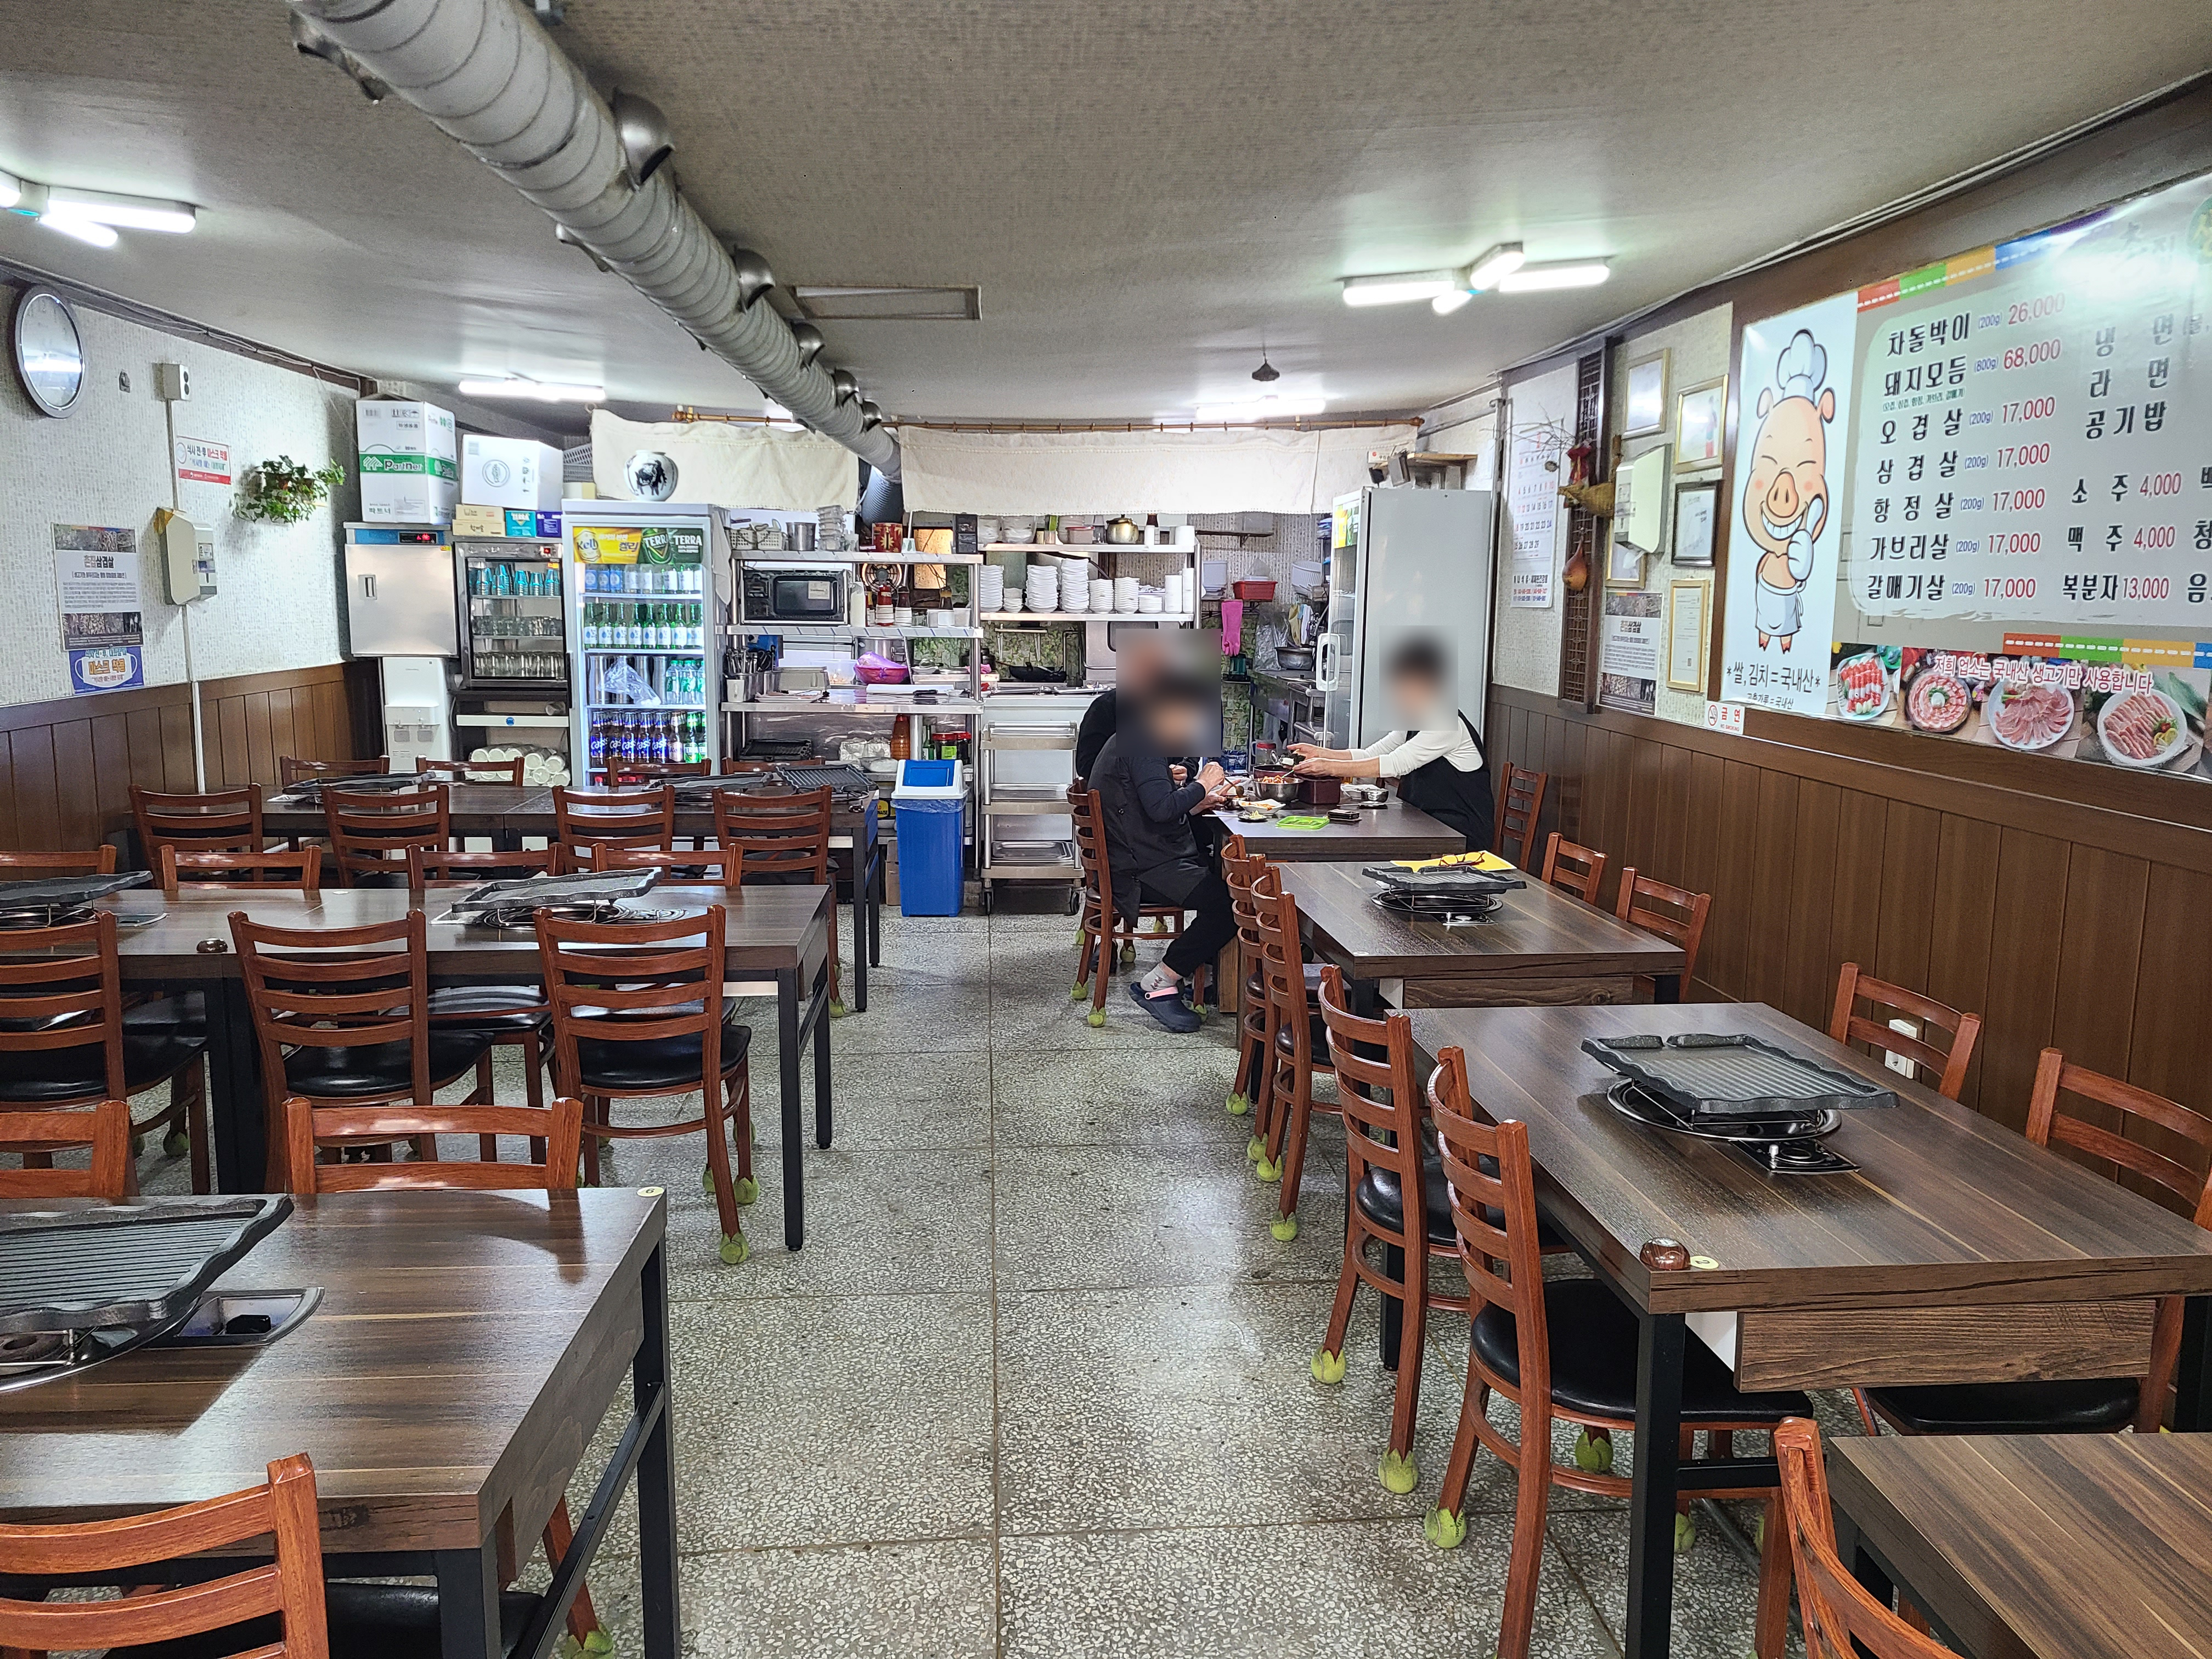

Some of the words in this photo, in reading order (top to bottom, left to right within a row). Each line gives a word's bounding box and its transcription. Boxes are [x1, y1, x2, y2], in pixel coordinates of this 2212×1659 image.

[1887, 313, 1971, 357] 차돌박이
[1978, 312, 2002, 329] (200g)
[2008, 292, 2065, 325] 26,000
[1884, 356, 1967, 397] 돼지모듬
[1974, 357, 1999, 373] (800g)
[2004, 338, 2061, 370] 68,000
[1969, 411, 1994, 426] (200g)
[2002, 397, 2056, 424] 17,000
[385, 460, 422, 471] Partner
[1965, 455, 1989, 470] (200g)
[1998, 443, 2050, 469] 17,000
[2140, 472, 2182, 498] 4,000
[1960, 497, 1984, 511] (200g)
[1993, 488, 2046, 512] 17,000
[673, 535, 702, 546] TERRA
[1870, 533, 1949, 561] 가브리살
[1956, 540, 1980, 554] (200g)
[1989, 533, 2041, 556] 17,000
[2134, 526, 2176, 551] 4,000
[1868, 575, 1945, 601] 갈매기살
[1952, 583, 1976, 596] (200g)
[1984, 578, 2036, 600] 17,000
[2063, 574, 2118, 601] 복분자
[2124, 577, 2169, 600] 13,000
[2188, 573, 2212, 603] 음
[88, 659, 111, 675] 마스크
[1934, 657, 1956, 676] 저희
[1958, 658, 1991, 680] 업소는
[1993, 661, 2029, 683] 국내산
[2032, 663, 2083, 690] 생고기만
[2085, 668, 2153, 695] 사용합니다
